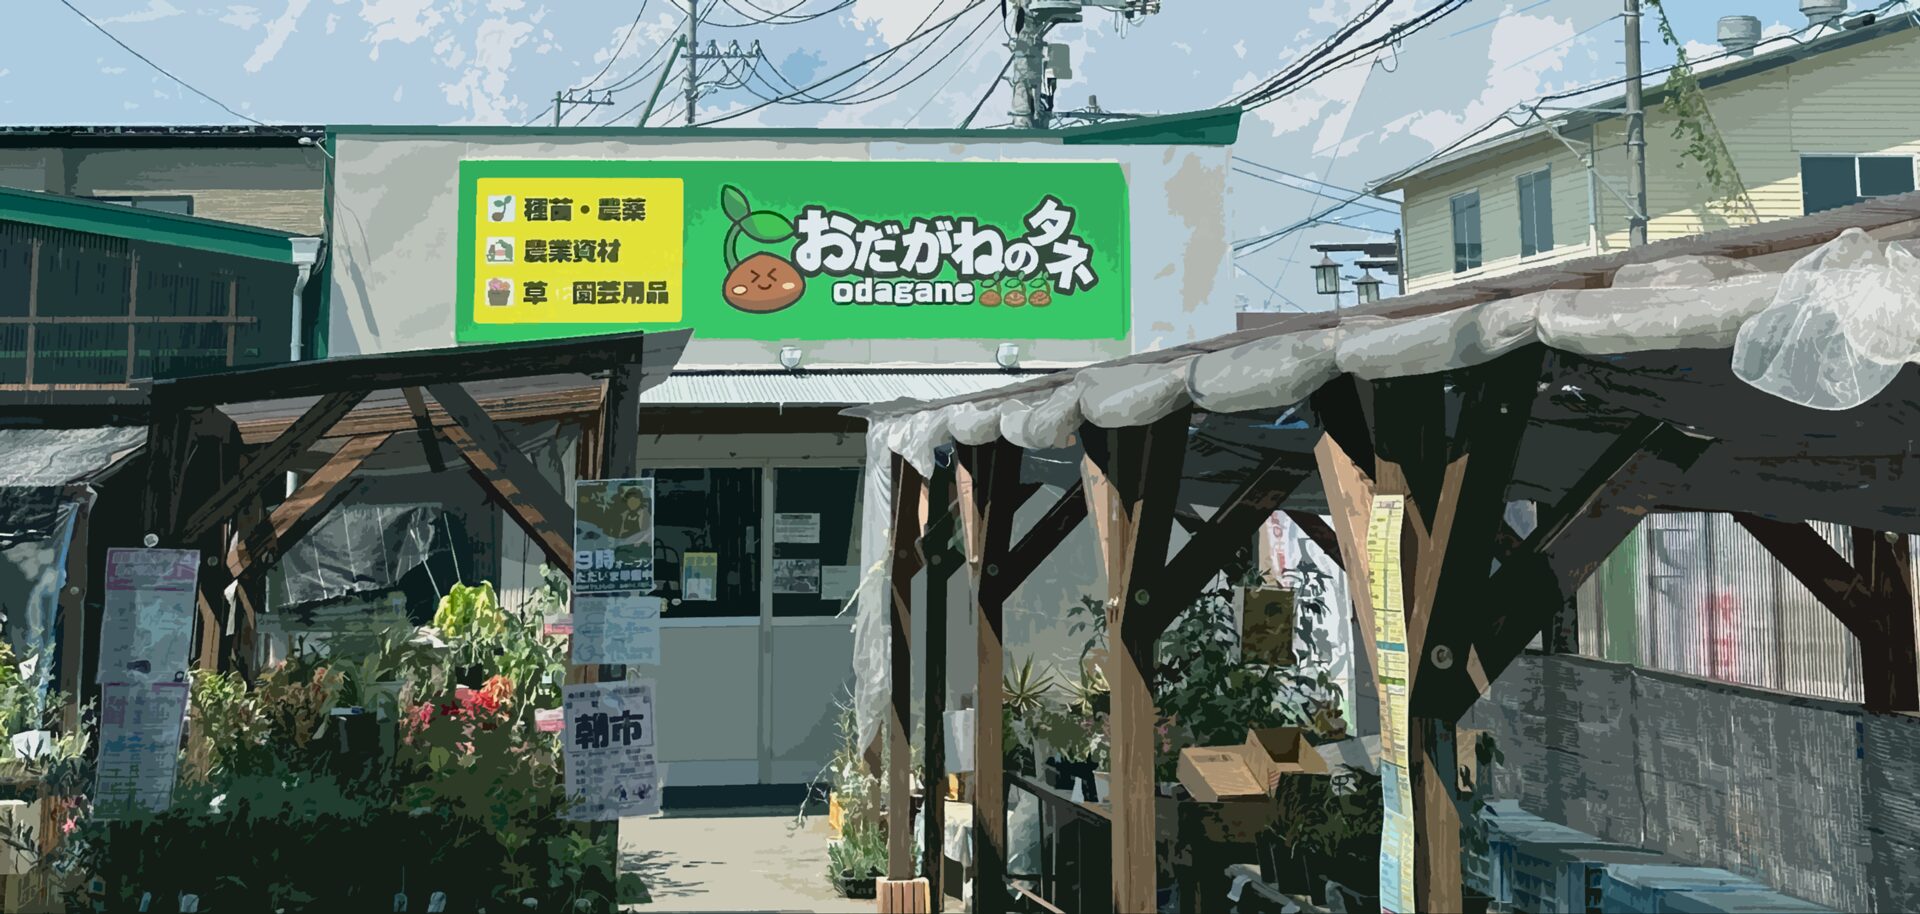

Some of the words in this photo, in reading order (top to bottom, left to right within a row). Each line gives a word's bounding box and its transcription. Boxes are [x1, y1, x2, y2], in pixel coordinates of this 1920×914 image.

[524, 238, 622, 263] 農業資材
[796, 198, 1095, 290] おだがねのタネ
[833, 278, 975, 305] odagane
[574, 709, 644, 749] 朝市
